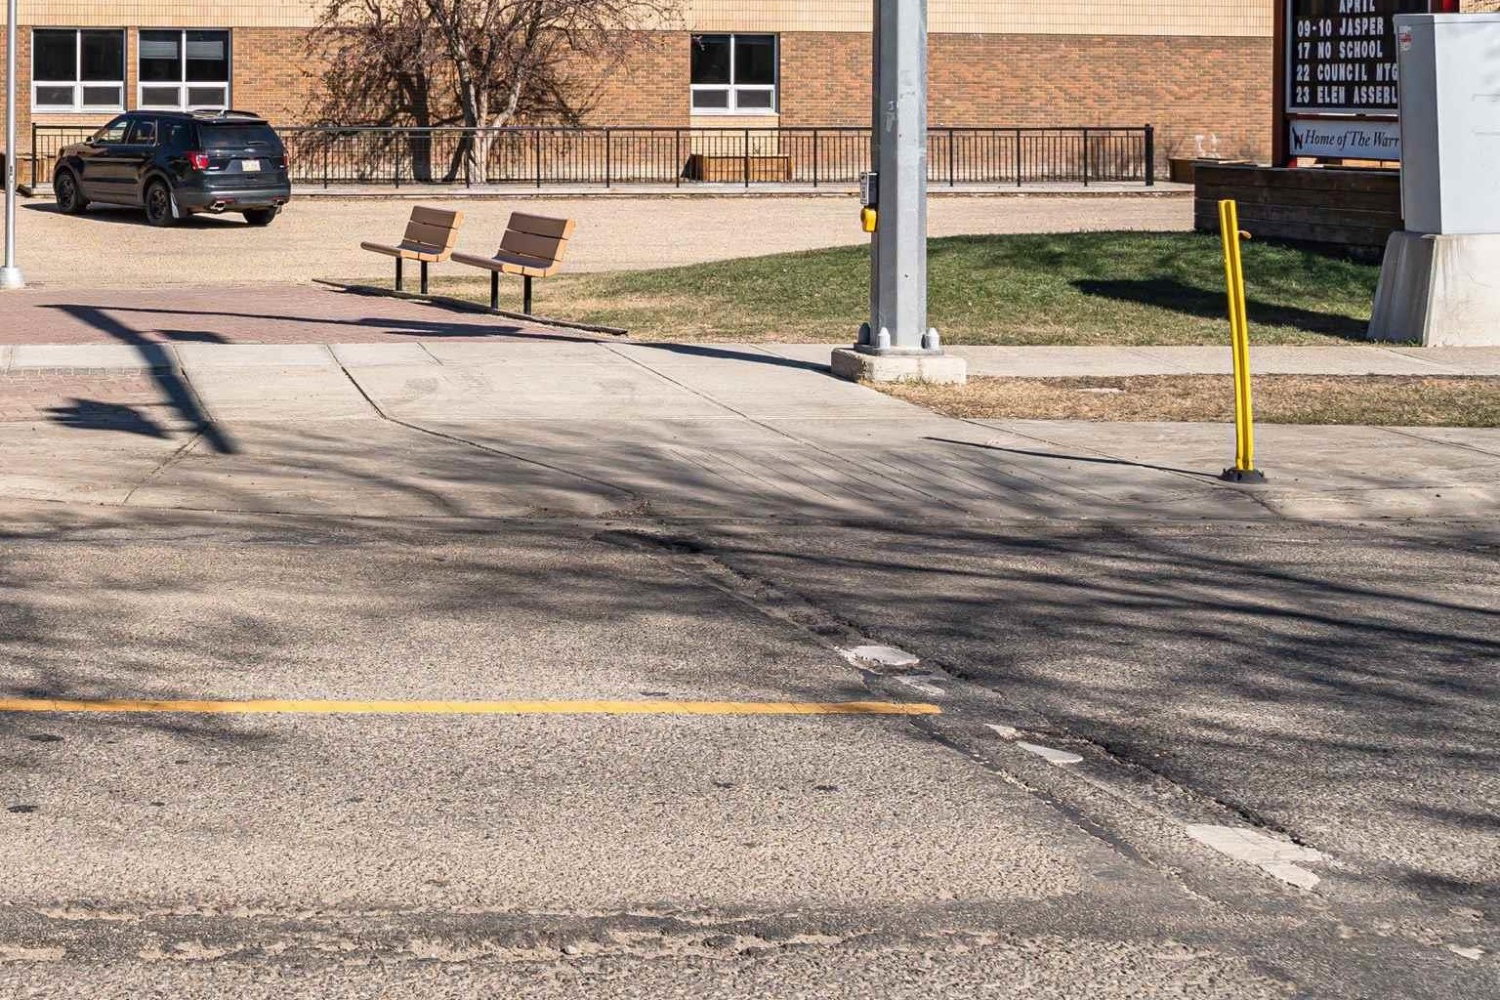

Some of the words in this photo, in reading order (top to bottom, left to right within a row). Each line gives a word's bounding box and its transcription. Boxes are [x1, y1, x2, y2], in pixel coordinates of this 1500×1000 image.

[1297, 18, 1332, 37] 09-10
[1340, 17, 1384, 36] JASPER
[1297, 42, 1311, 59] 17
[1317, 41, 1332, 59] NO
[1339, 40, 1383, 59] SCHOOL
[1296, 64, 1310, 81] 22
[1317, 63, 1368, 81] COUNCIL
[1296, 86, 1310, 103] 23
[1304, 129, 1336, 145] Home
[1337, 130, 1348, 151] of
[1348, 131, 1371, 147] The
